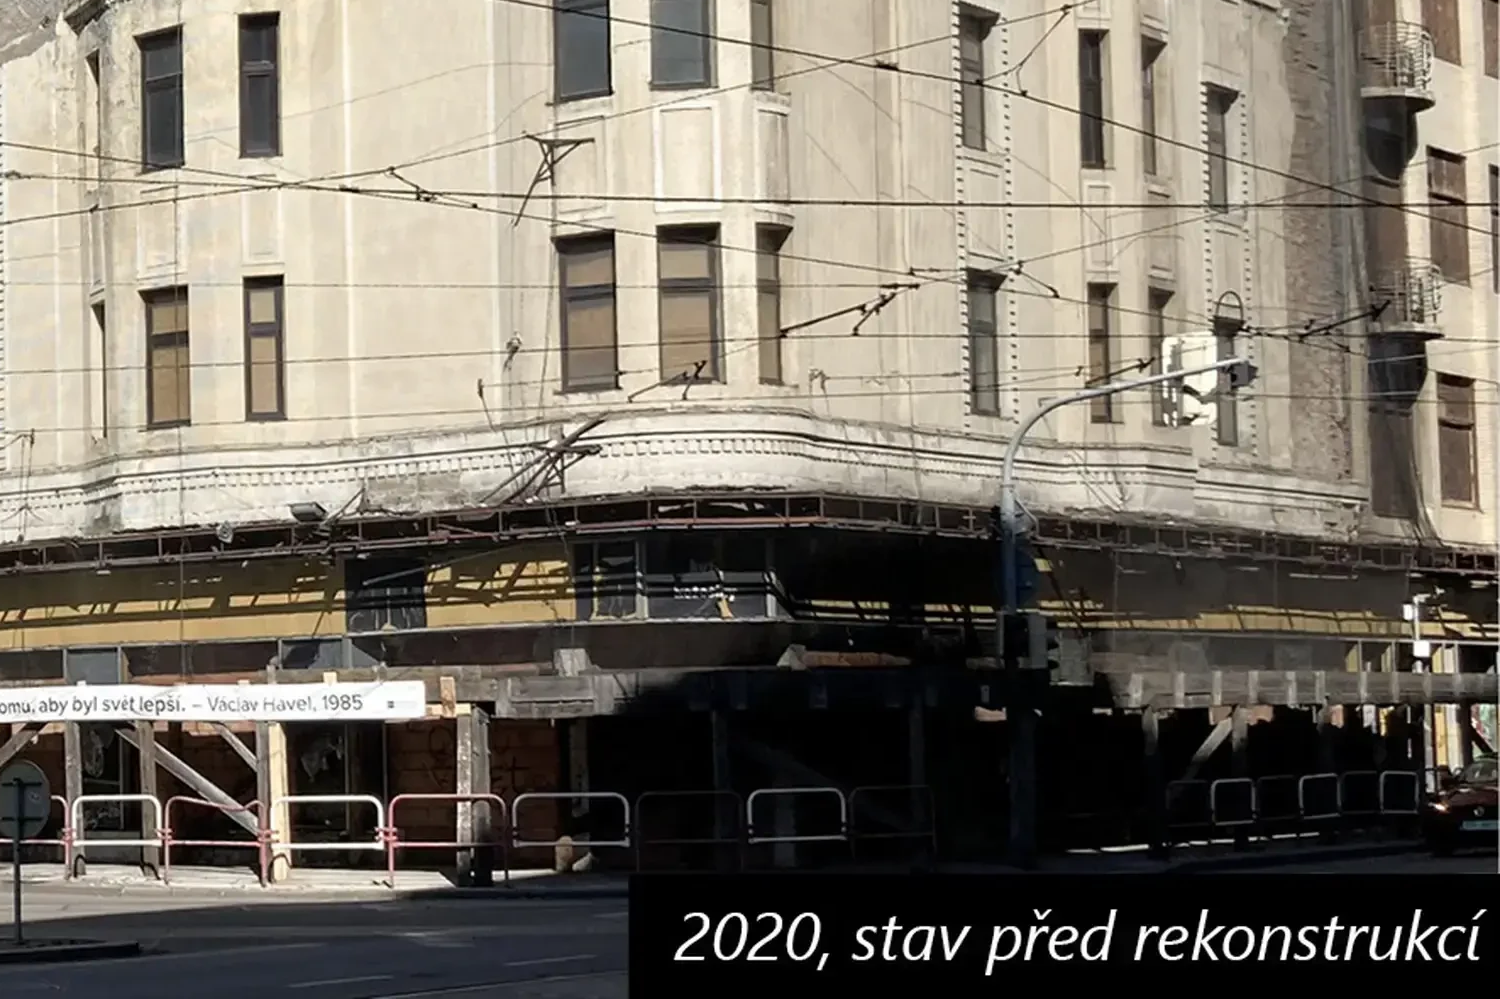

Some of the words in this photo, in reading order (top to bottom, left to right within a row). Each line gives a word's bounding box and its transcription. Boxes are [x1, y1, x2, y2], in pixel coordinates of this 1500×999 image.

[39, 698, 68, 716] aby
[72, 695, 98, 715] byl
[102, 695, 135, 714] svět
[139, 695, 186, 716] lepší.
[207, 696, 259, 712] Václav
[263, 696, 317, 713] Havel,
[323, 694, 363, 711] 1985
